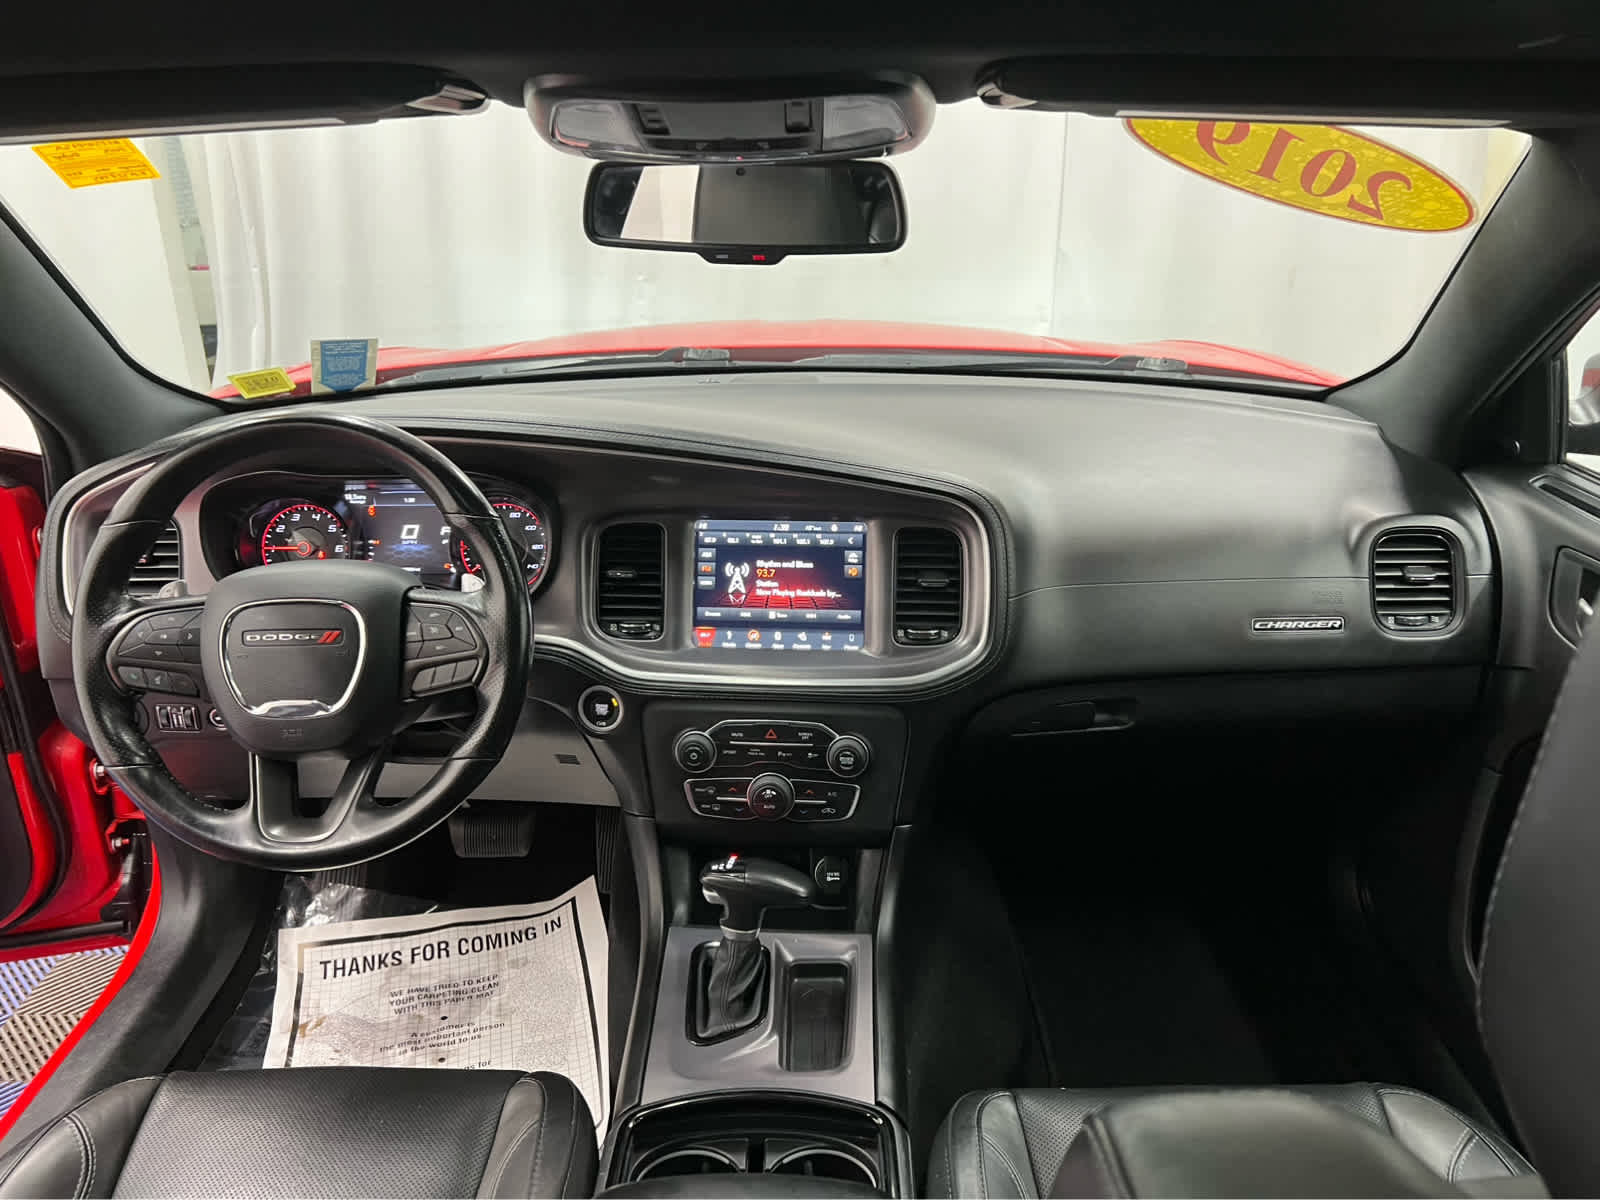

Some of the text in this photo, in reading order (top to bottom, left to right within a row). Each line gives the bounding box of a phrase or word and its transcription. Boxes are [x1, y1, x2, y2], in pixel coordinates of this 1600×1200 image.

[312, 513, 321, 521] 4
[275, 525, 286, 533] 2
[328, 525, 337, 533] 5
[756, 568, 776, 578] 93.7
[1254, 620, 1342, 630] CHARGER
[246, 633, 318, 643] DODGE
[320, 916, 562, 980] THANKS FOR COMING IN
[390, 990, 404, 998] WE
[408, 986, 430, 994] HAVE
[434, 982, 459, 991] TRIED
[476, 974, 498, 984] KEEP
[389, 982, 499, 1006] YOUR CARPETING CLEAN
[394, 1004, 418, 1015] WITH
[421, 1000, 442, 1009] THIS
[476, 990, 495, 1000] MAT
[398, 1038, 422, 1049] most
[472, 1022, 505, 1034] person
[428, 1040, 456, 1049] world
[458, 1036, 468, 1044] to
[478, 1060, 492, 1068] for
